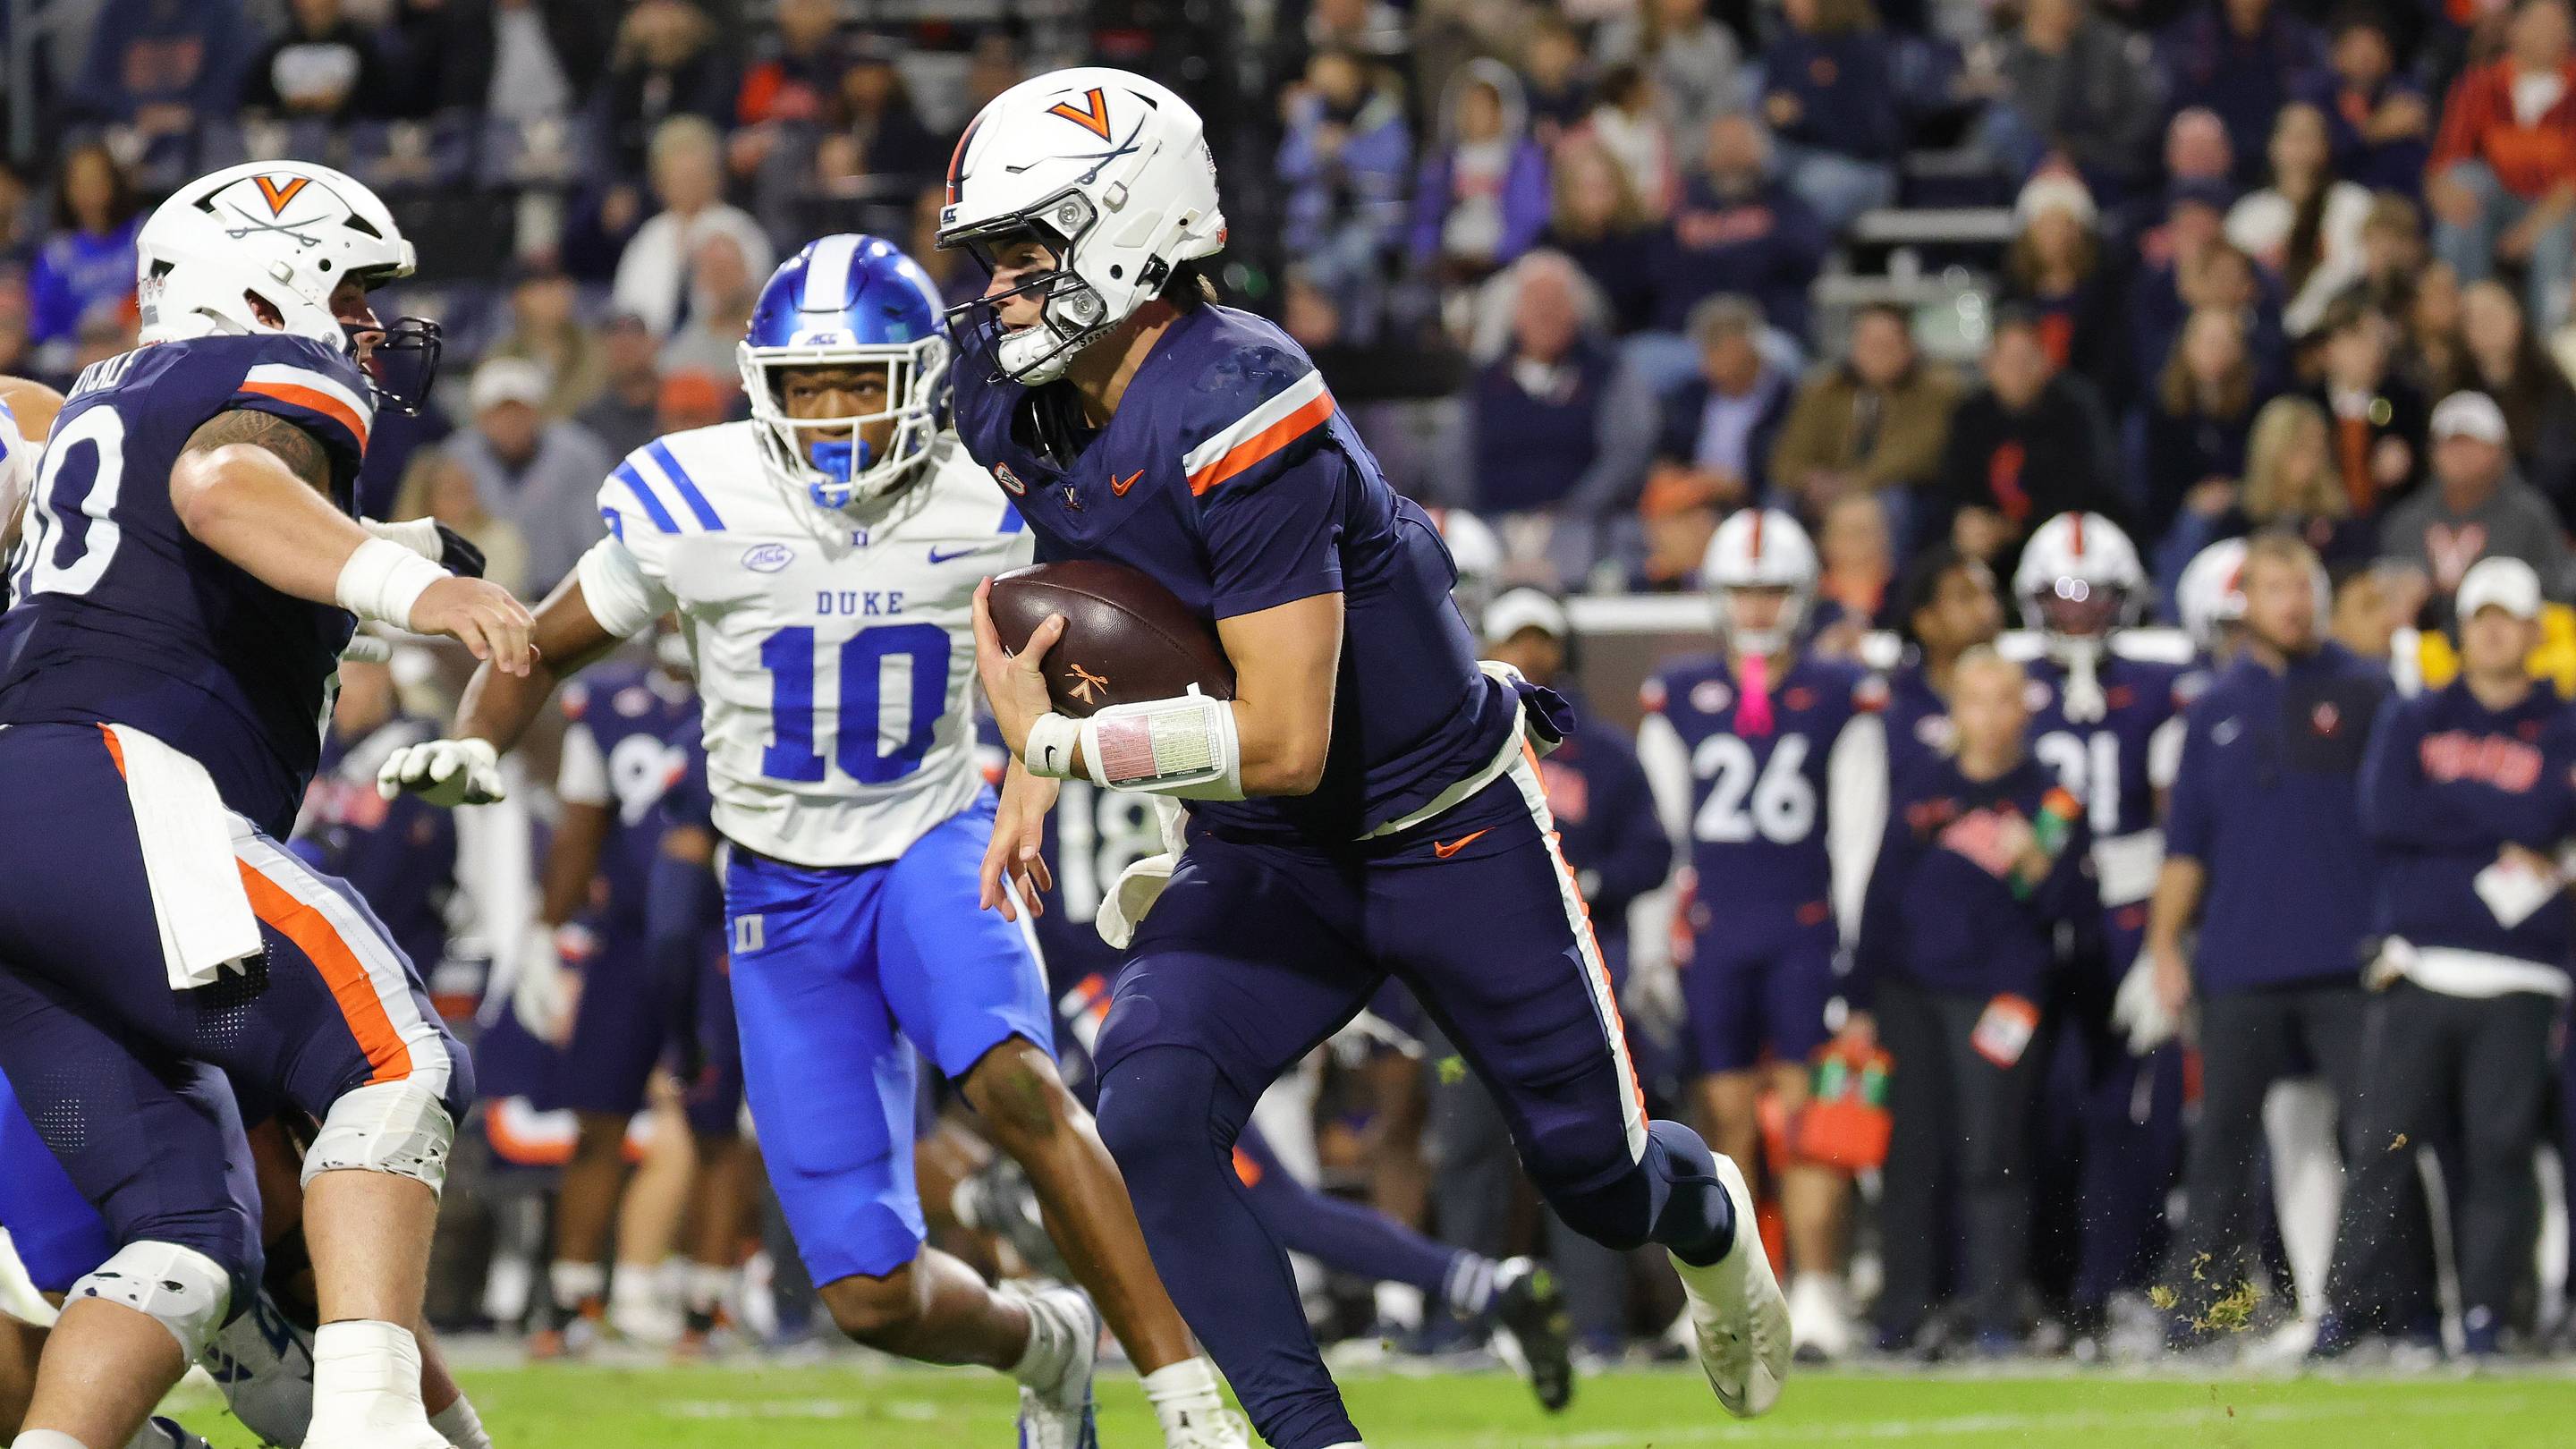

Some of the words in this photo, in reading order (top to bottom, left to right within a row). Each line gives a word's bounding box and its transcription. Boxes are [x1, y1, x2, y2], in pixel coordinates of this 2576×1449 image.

[816, 590, 905, 616] DUKE
[759, 623, 951, 785] 10
[1691, 732, 1818, 844] 26
